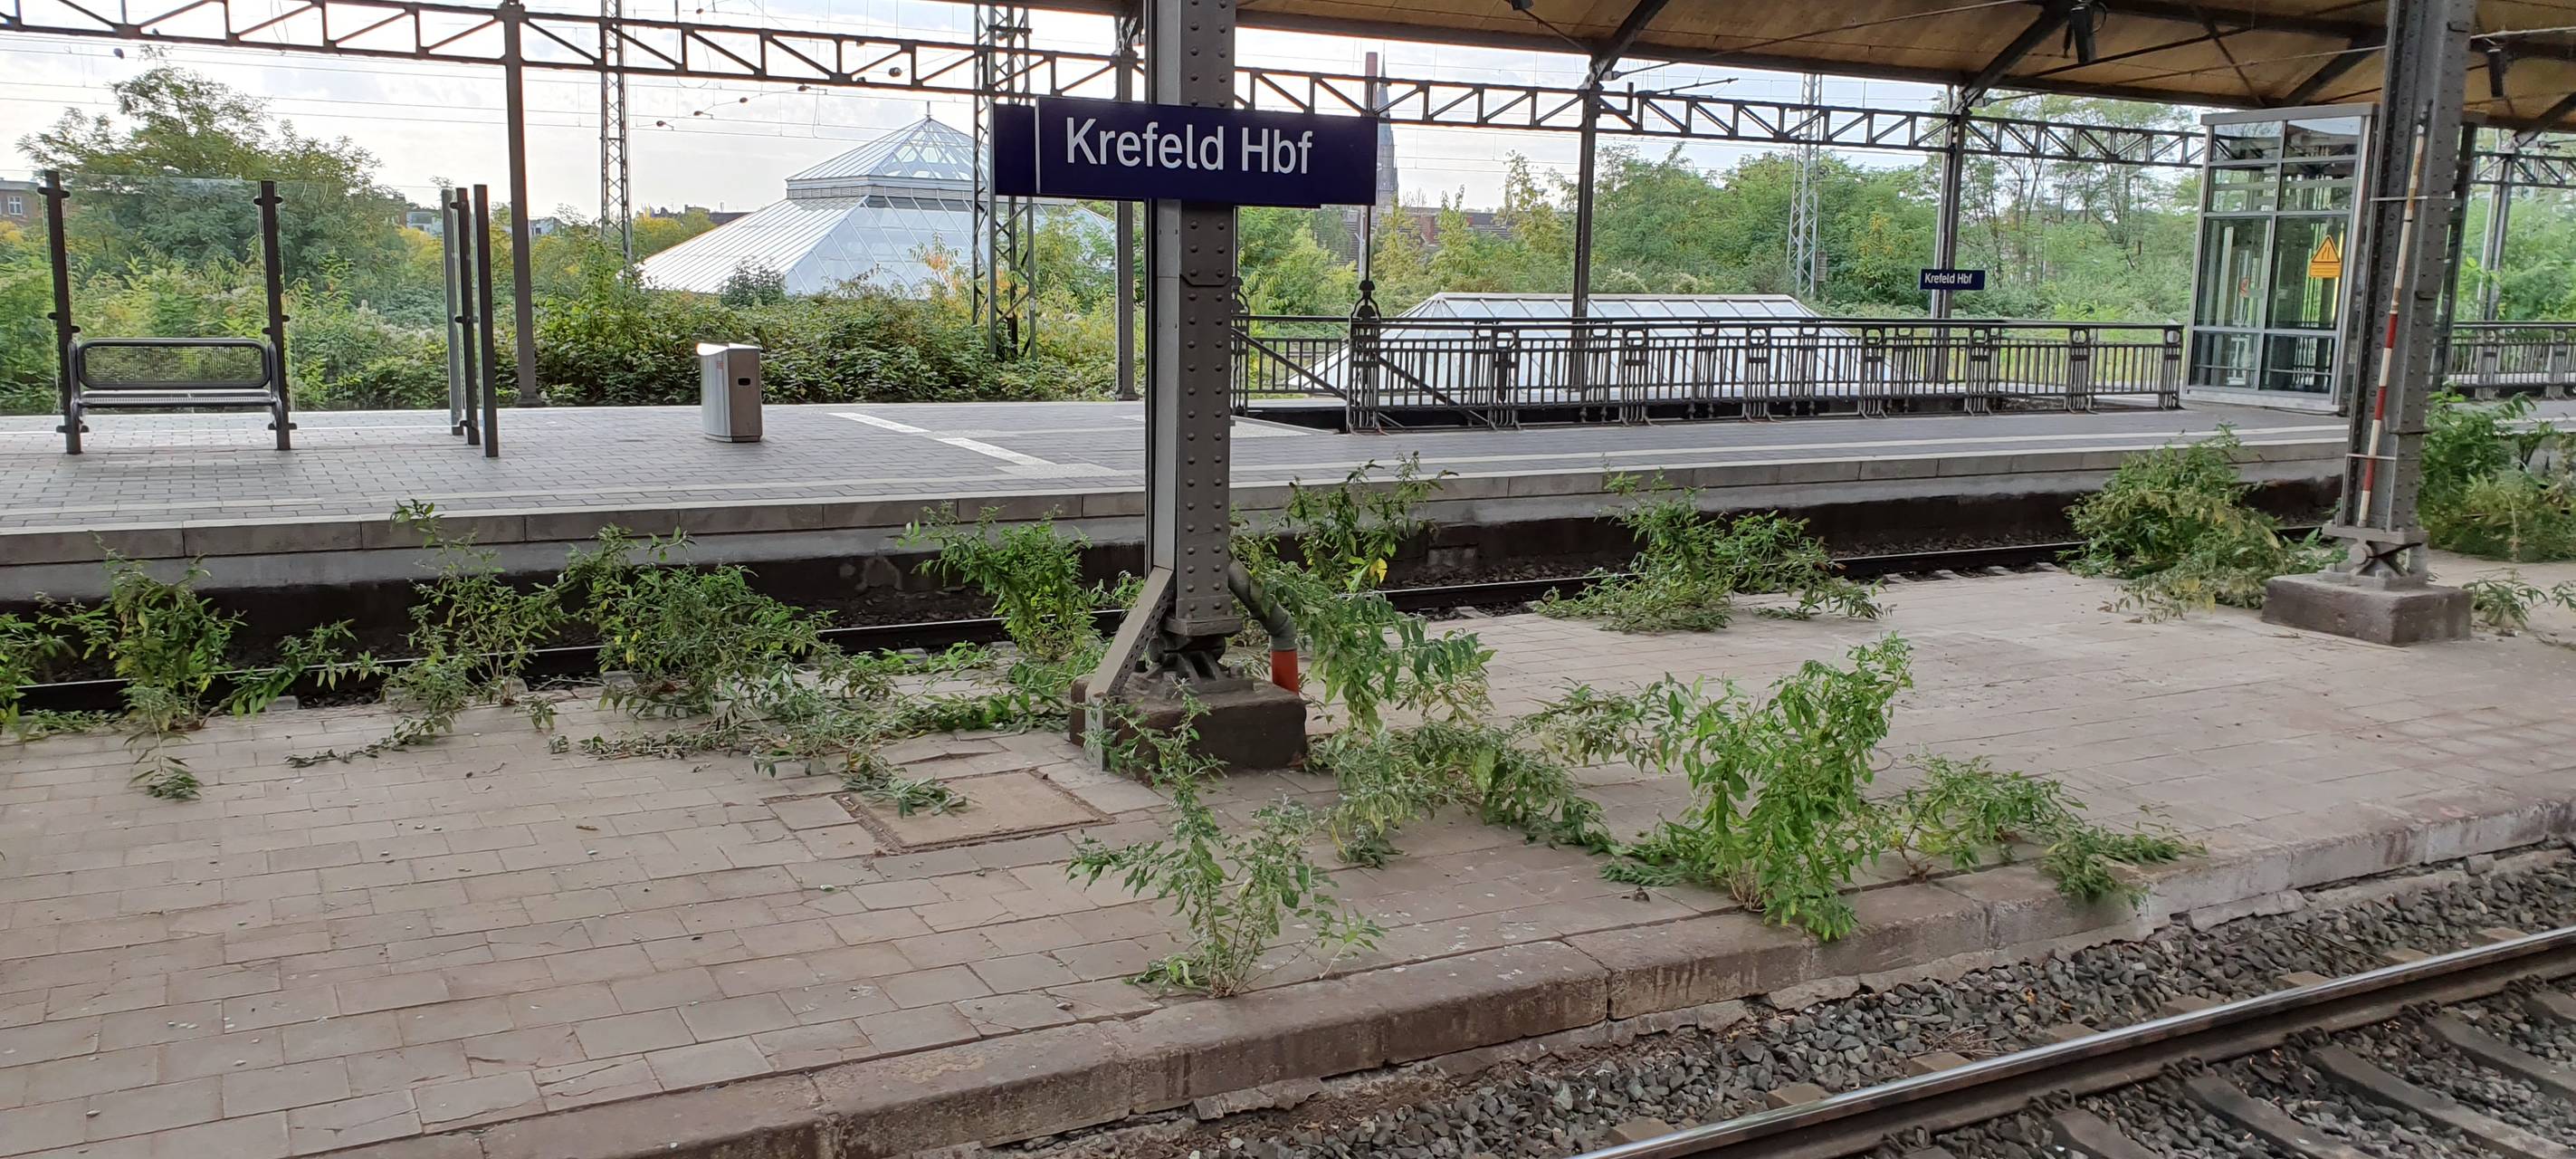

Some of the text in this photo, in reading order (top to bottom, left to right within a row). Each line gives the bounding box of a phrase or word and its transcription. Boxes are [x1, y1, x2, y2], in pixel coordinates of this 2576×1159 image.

[1066, 117, 1312, 174] Krefeld Hbf
[1924, 273, 1972, 284] Krefeld Hbf
